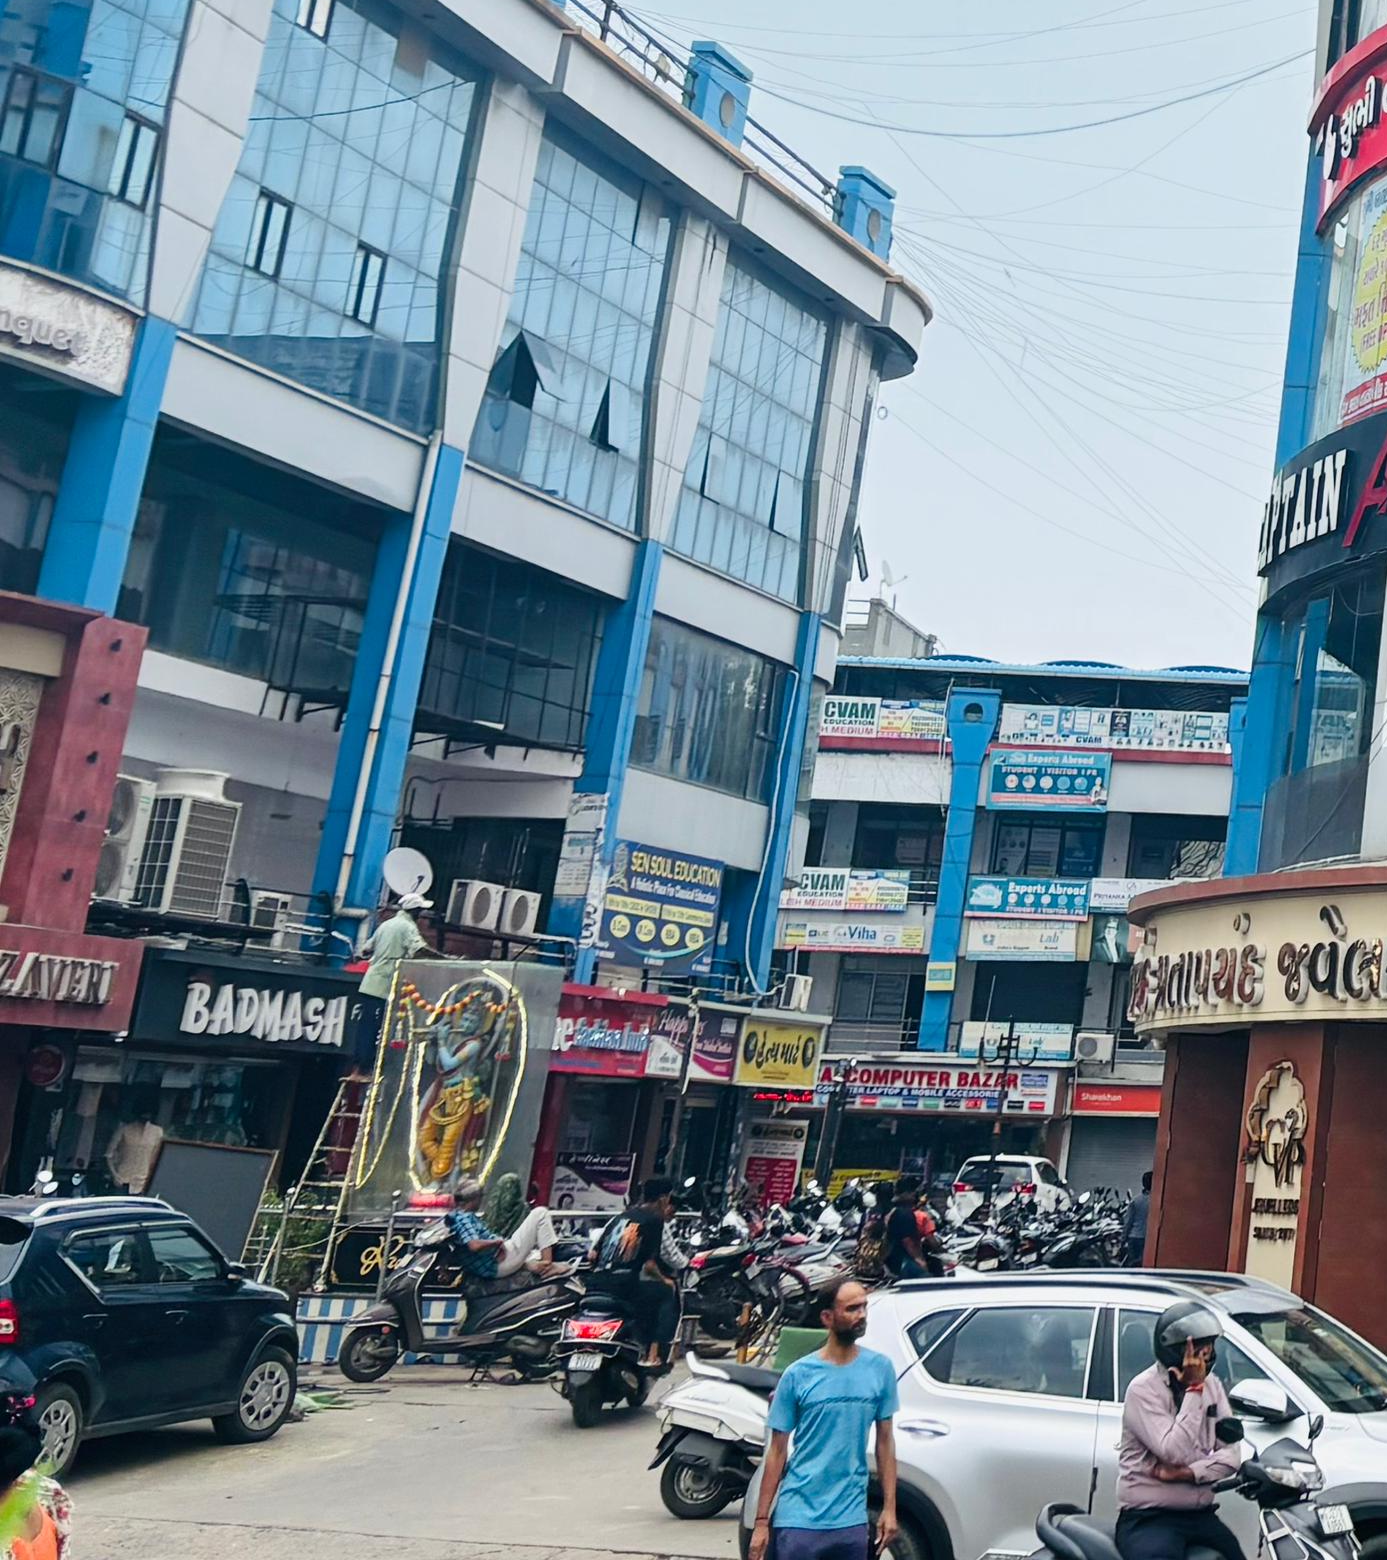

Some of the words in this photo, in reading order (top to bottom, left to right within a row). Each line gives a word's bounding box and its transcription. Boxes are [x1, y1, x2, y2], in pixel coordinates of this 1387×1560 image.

[824, 701, 877, 720] CVAM
[824, 718, 875, 726] EDUCATION
[673, 861, 721, 888] EDUCATION
[800, 873, 846, 891] CVAM
[797, 890, 844, 898] EDUCATION
[1008, 881, 1046, 895] Experts
[1049, 882, 1087, 896] Abroad
[180, 983, 349, 1048] BADMASH
[848, 1068, 953, 1089] COMPUTER
[957, 1071, 1019, 1090] BAZAR
